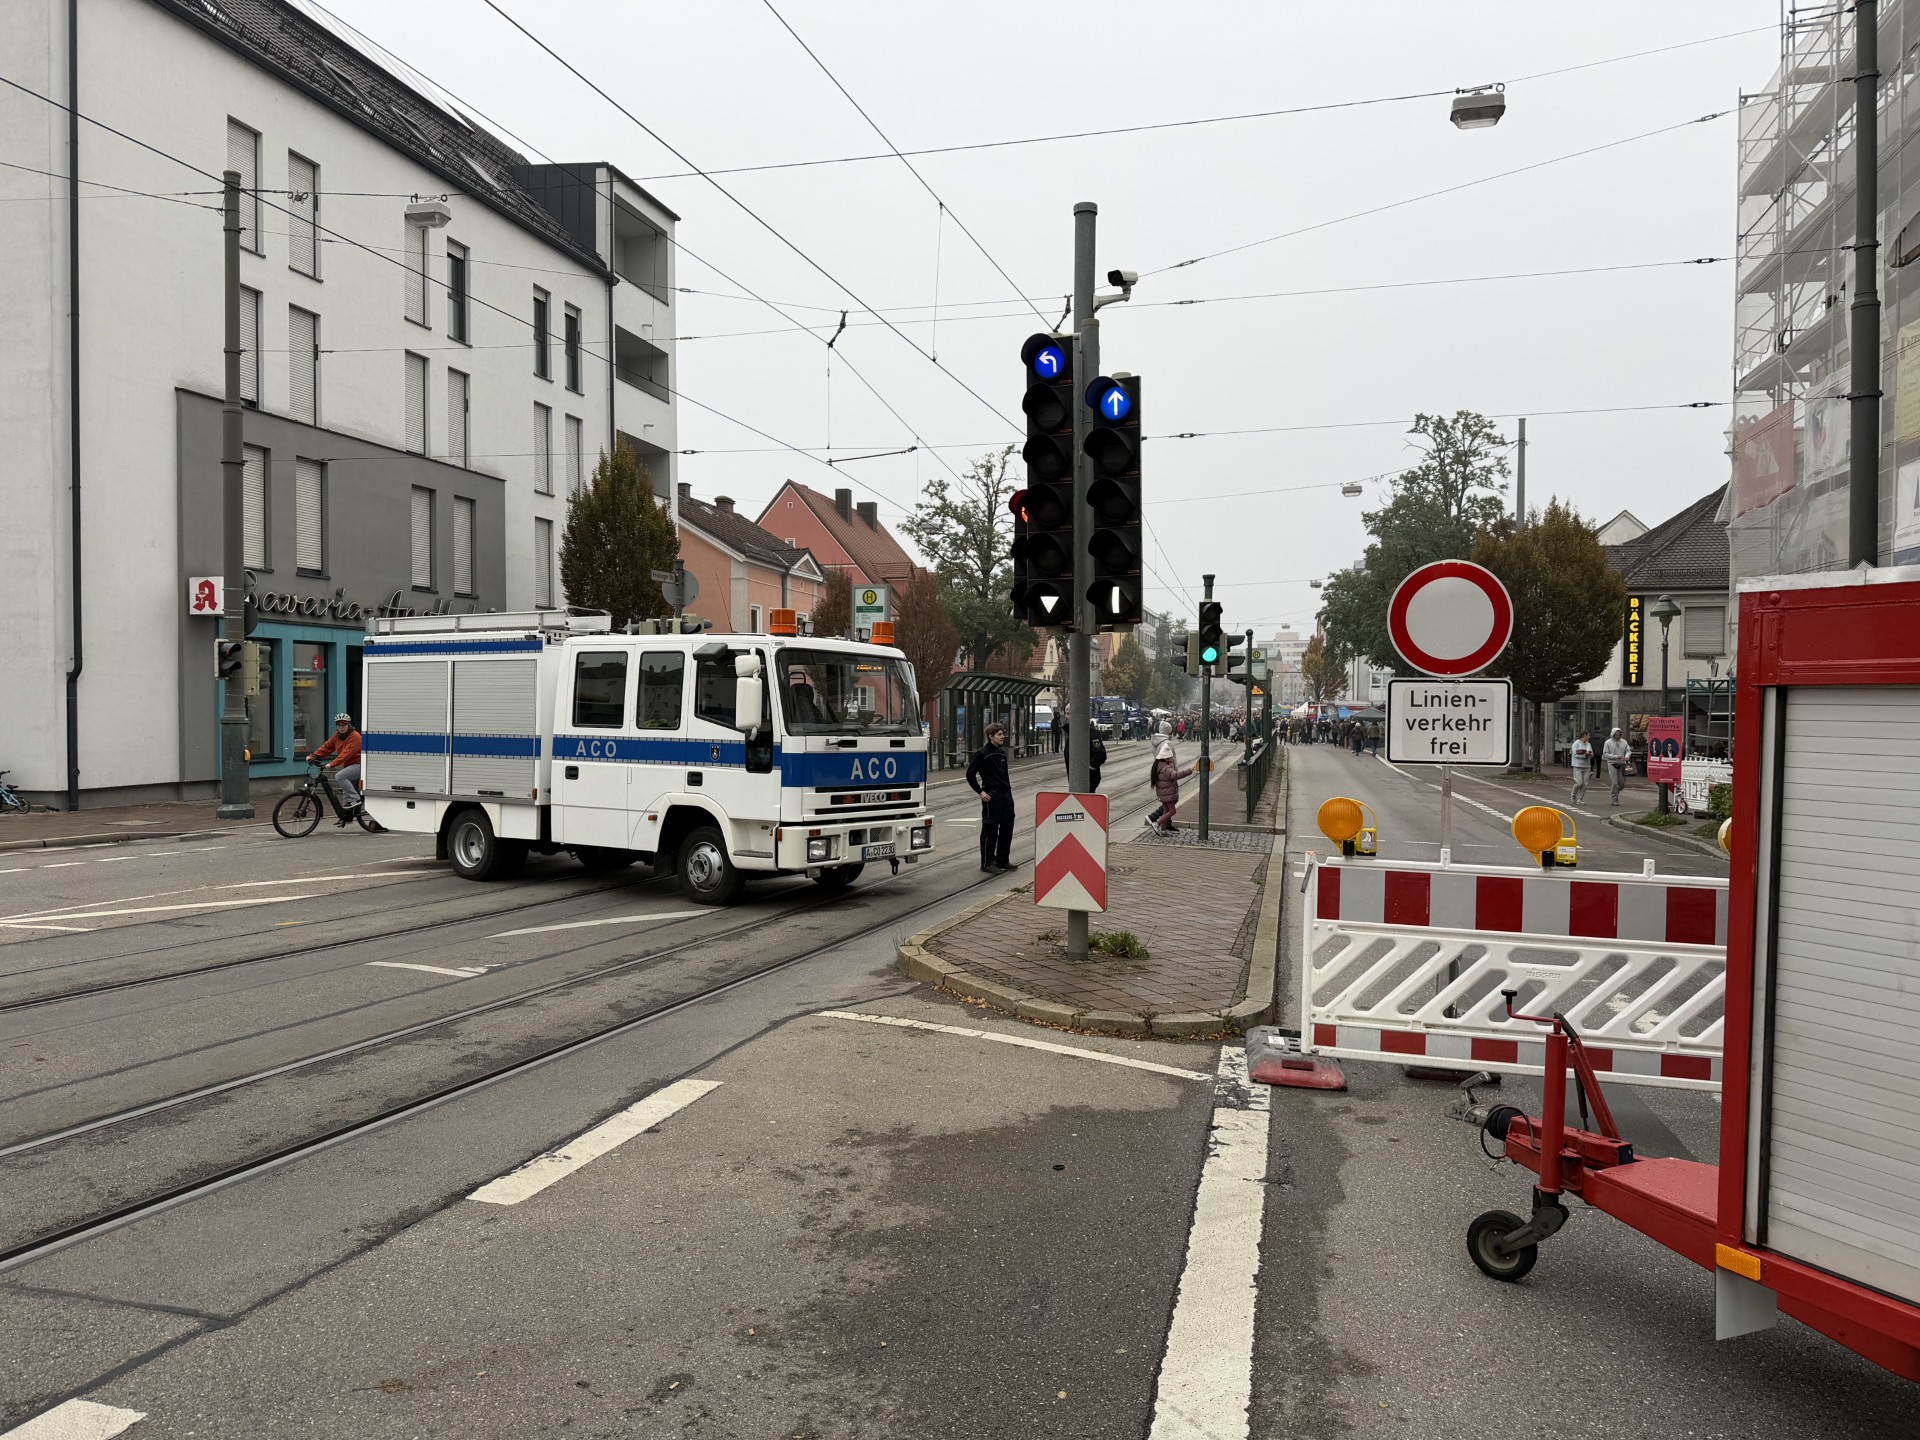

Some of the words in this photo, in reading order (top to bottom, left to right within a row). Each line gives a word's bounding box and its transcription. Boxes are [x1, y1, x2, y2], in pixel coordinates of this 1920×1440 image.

[1630, 597, 1640, 684] BÄCKEREI
[1410, 690, 1487, 708] Linien-
[1405, 713, 1492, 731] verkehr
[575, 739, 617, 758] ACO
[1430, 737, 1467, 755] frei
[850, 757, 897, 780] ACO
[860, 792, 887, 803] IVECO
[1526, 968, 1562, 979] nissen
